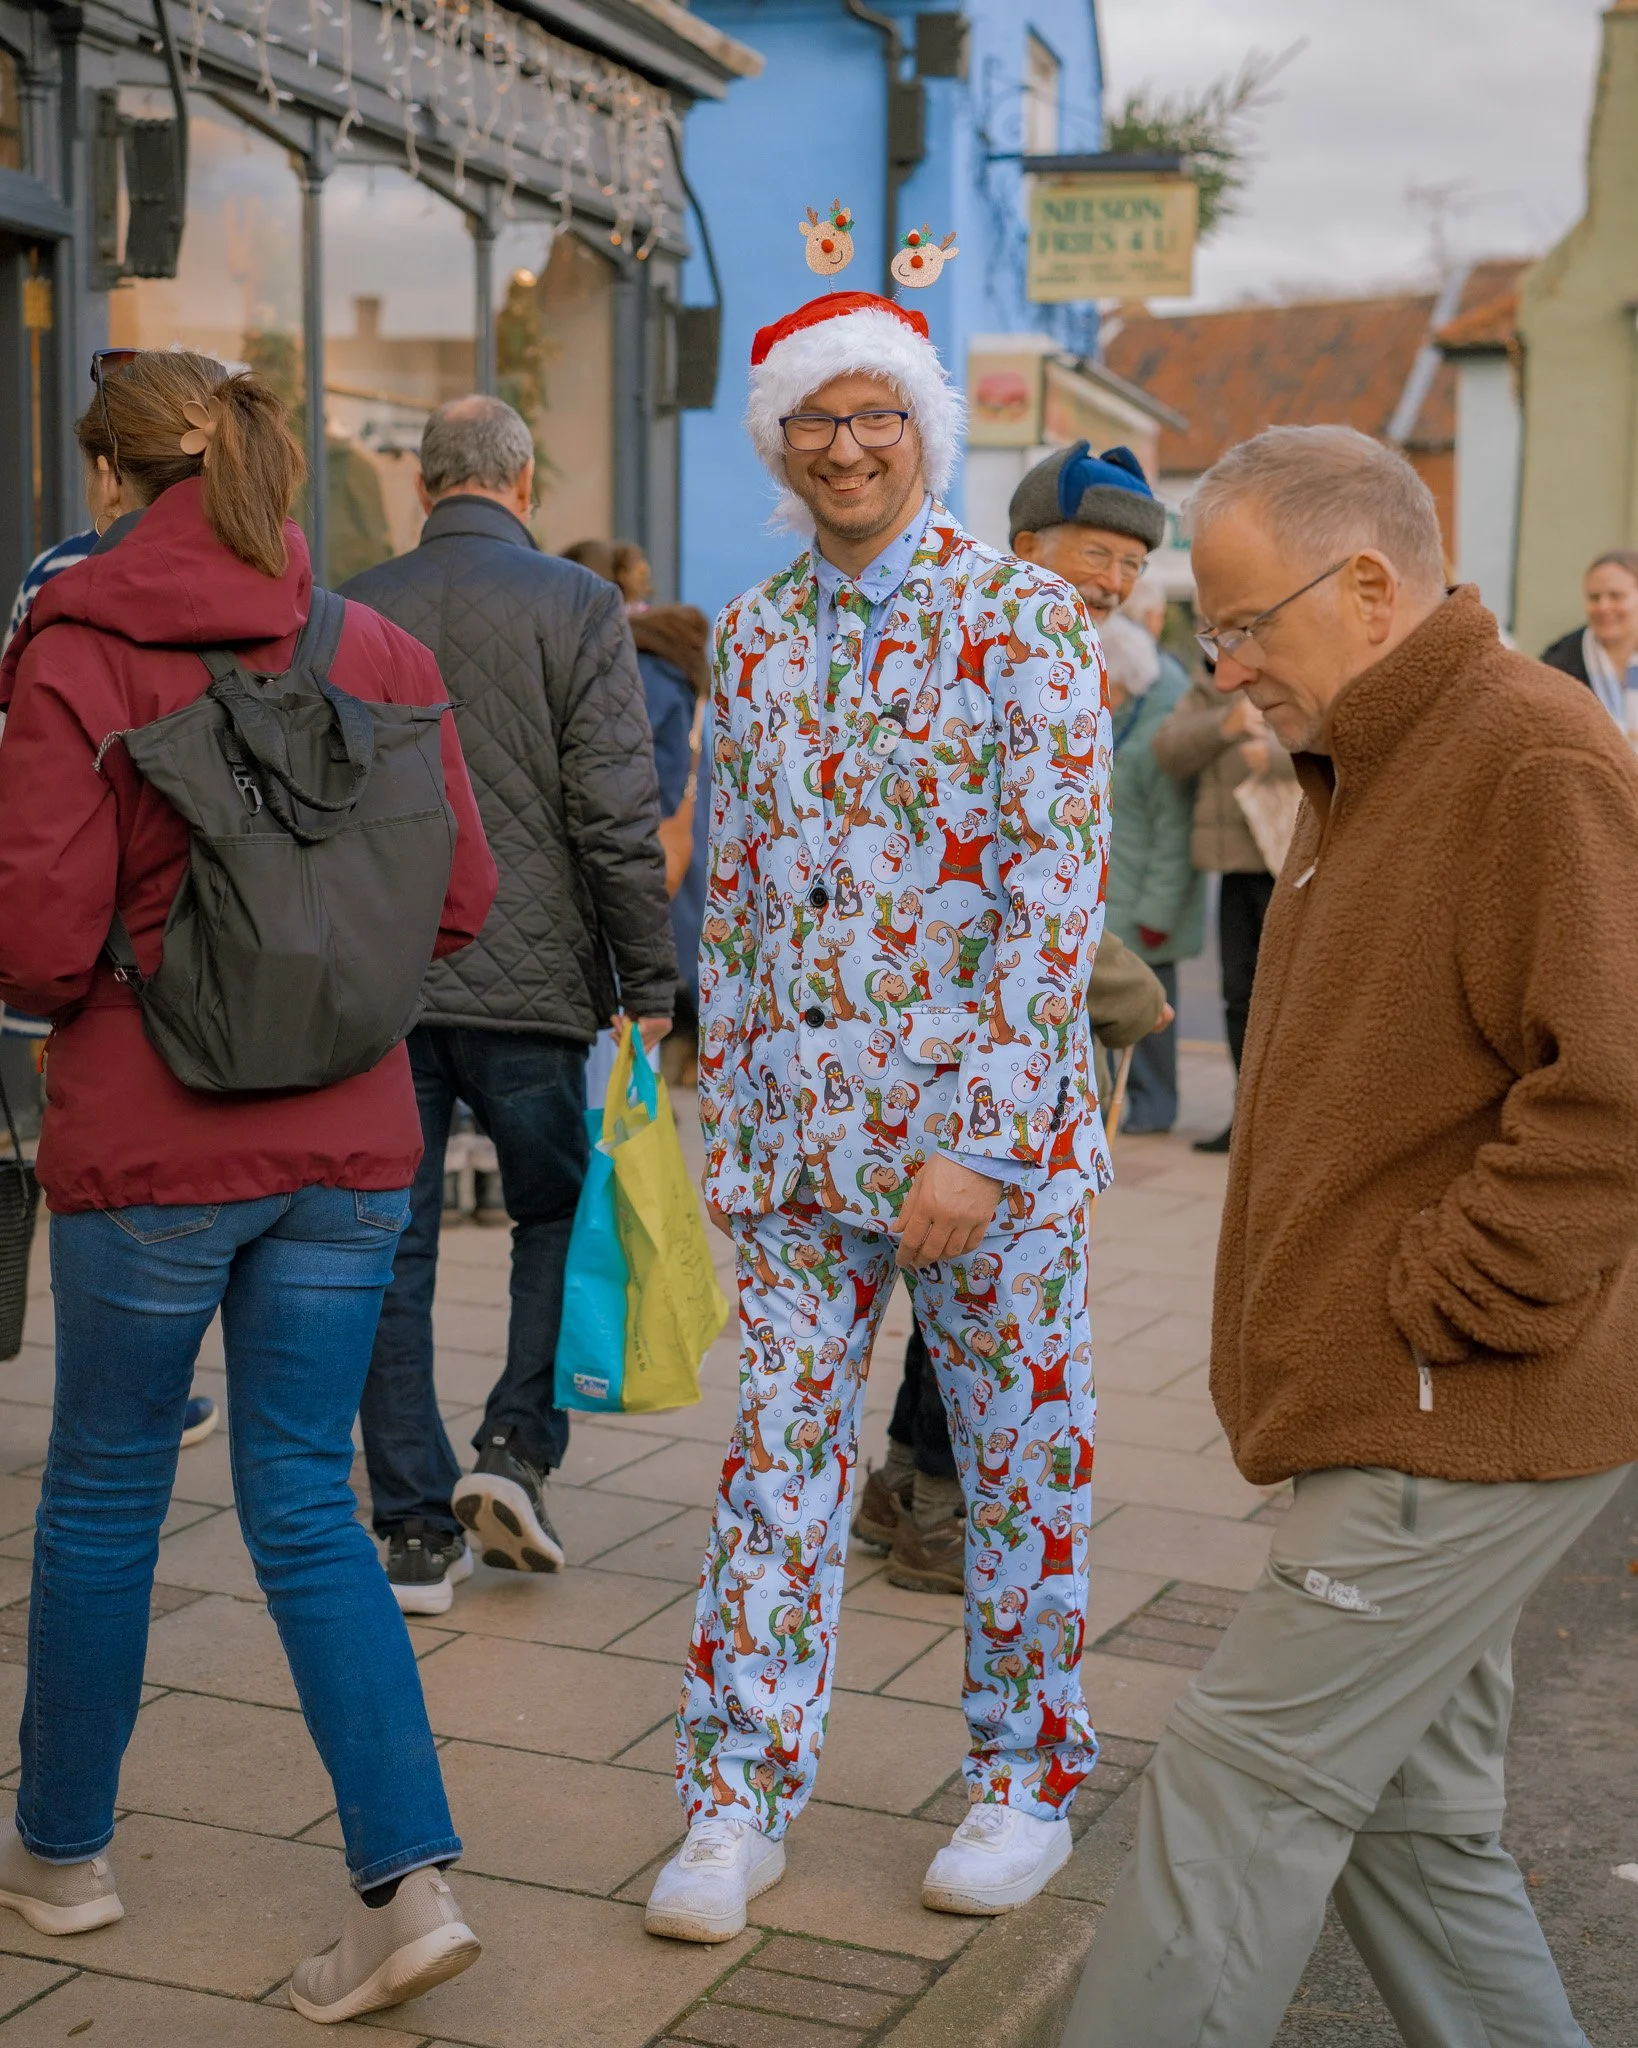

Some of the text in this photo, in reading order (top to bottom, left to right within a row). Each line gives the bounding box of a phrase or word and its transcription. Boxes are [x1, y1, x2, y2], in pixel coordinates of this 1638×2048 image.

[1042, 199, 1162, 222] NELSON
[1037, 229, 1117, 253] FRIES
[1331, 1579, 1360, 1597] Jack
